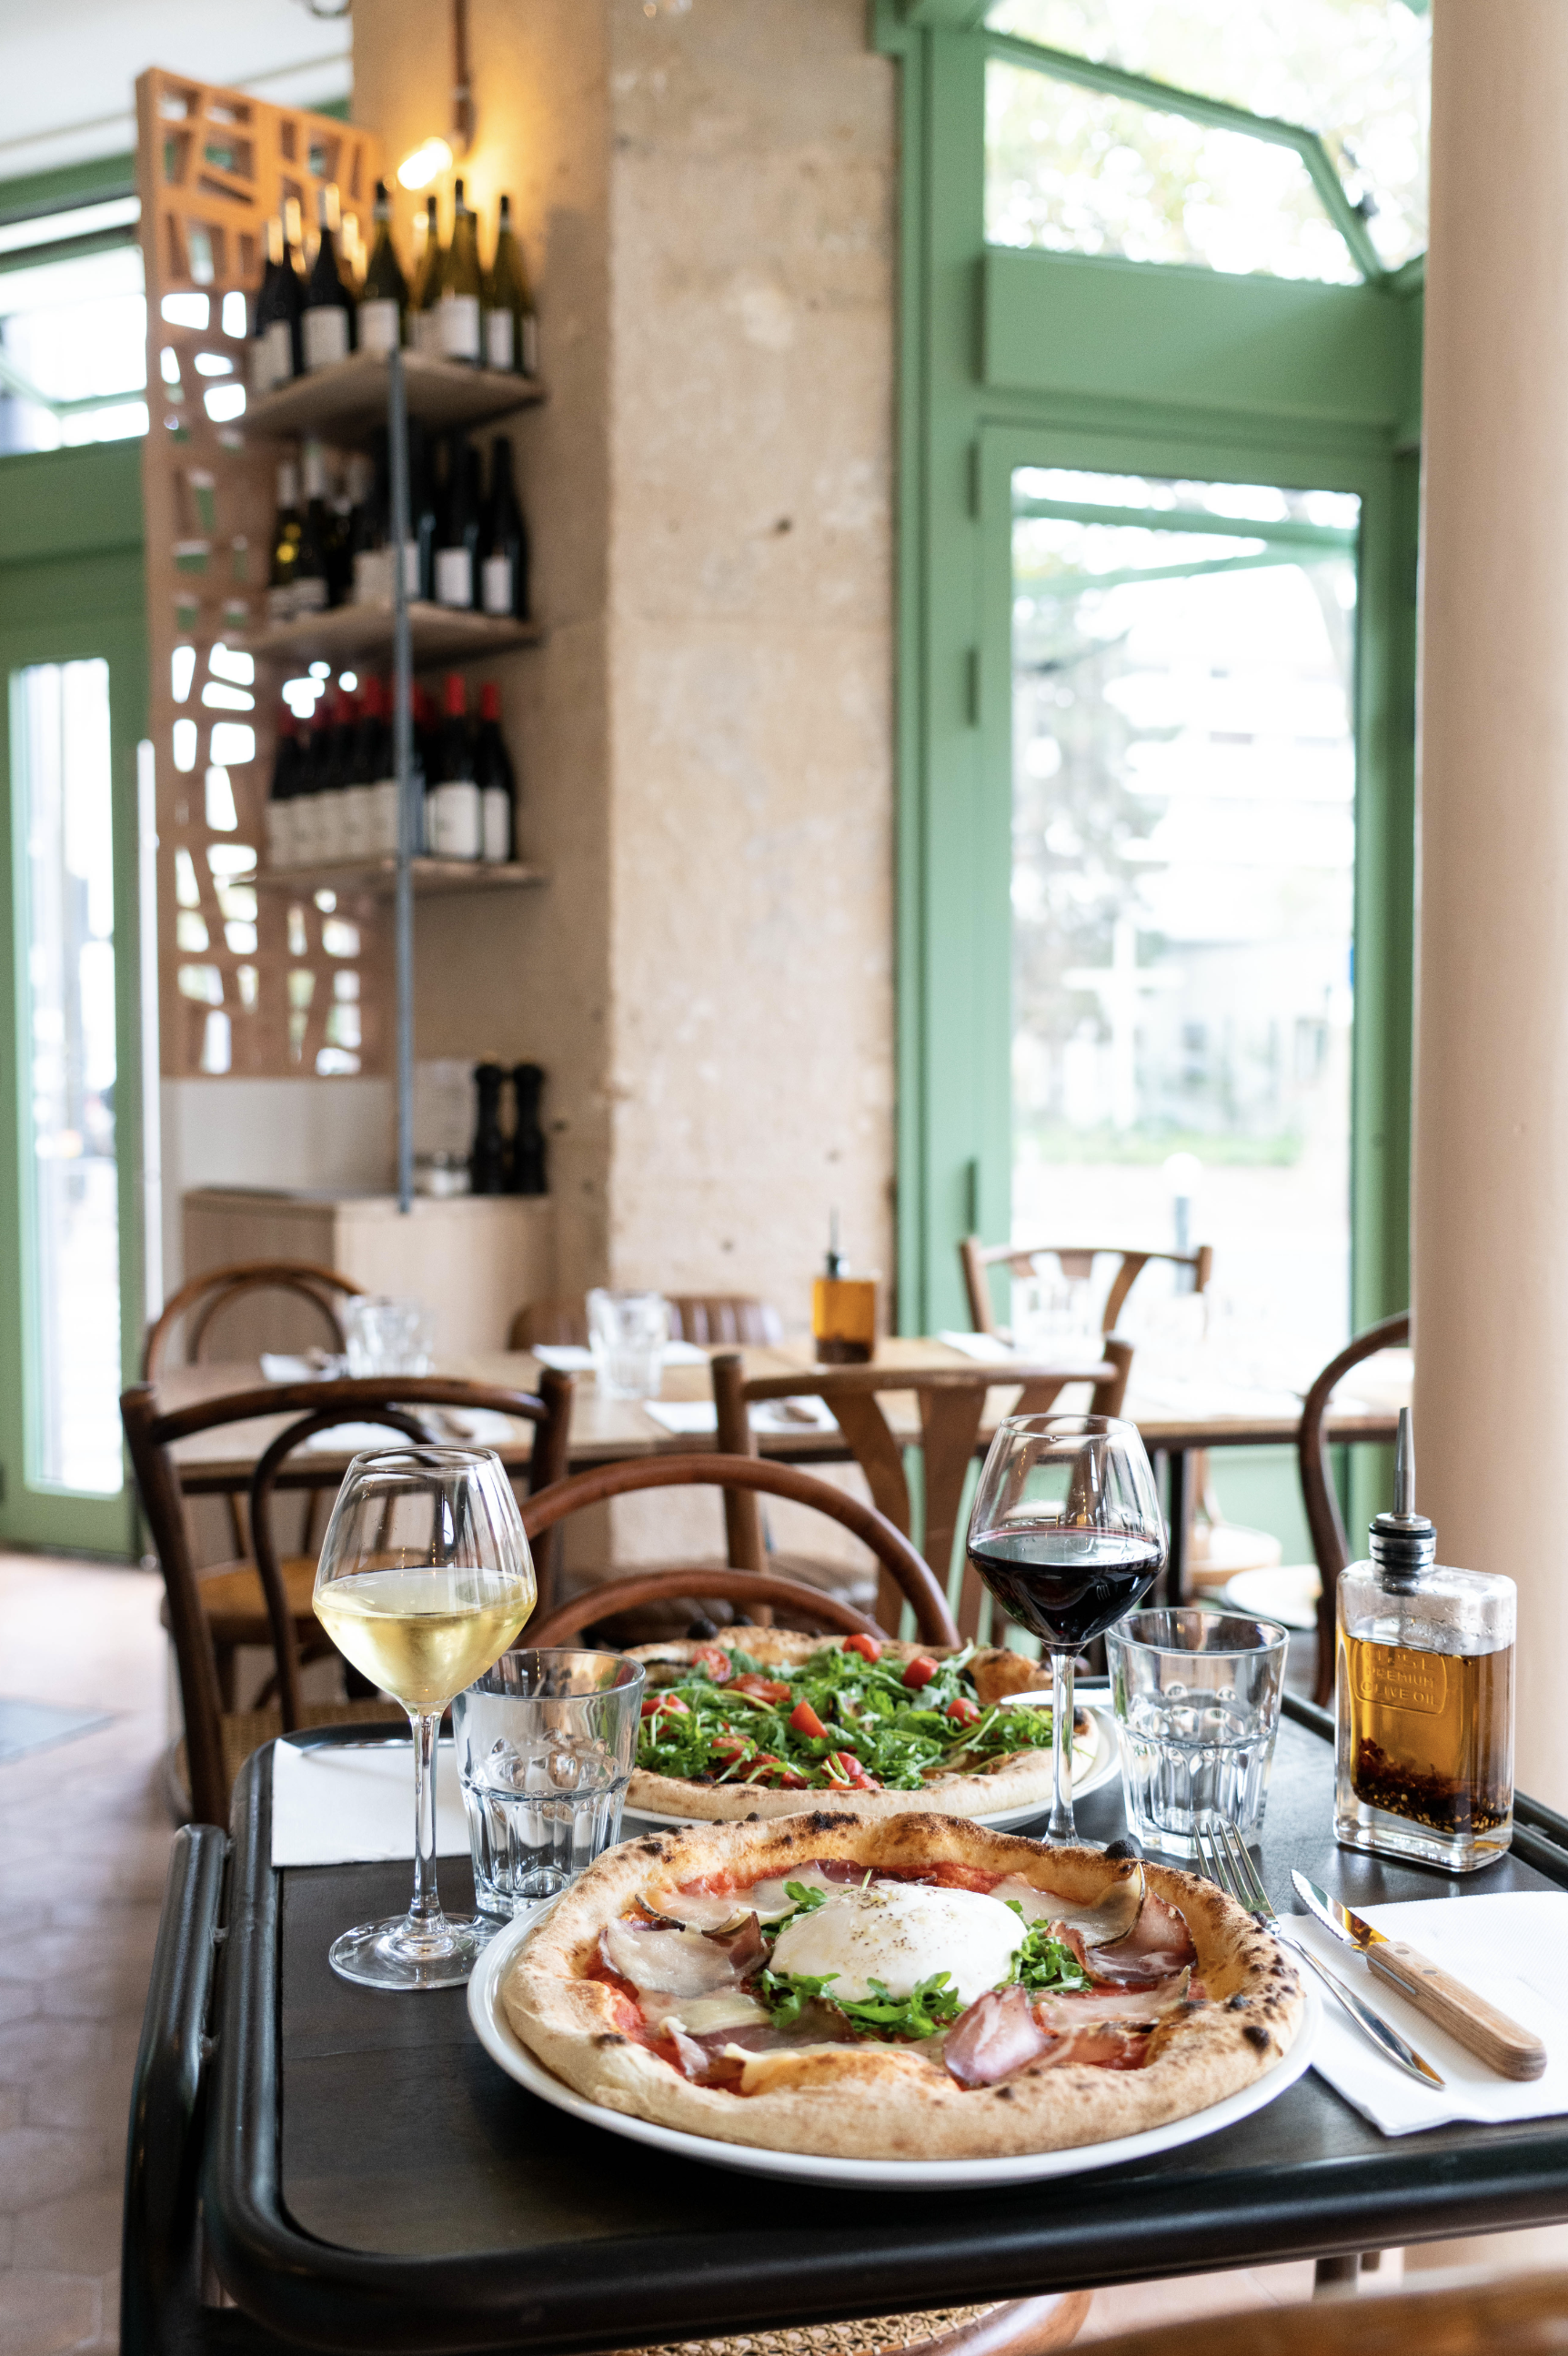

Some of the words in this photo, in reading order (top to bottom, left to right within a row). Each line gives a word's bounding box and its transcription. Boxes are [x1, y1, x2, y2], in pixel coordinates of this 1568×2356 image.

[1365, 1666, 1434, 1688] PREMIUM
[1361, 1681, 1410, 1700] OLIVE
[1413, 1692, 1437, 1706] OIL
